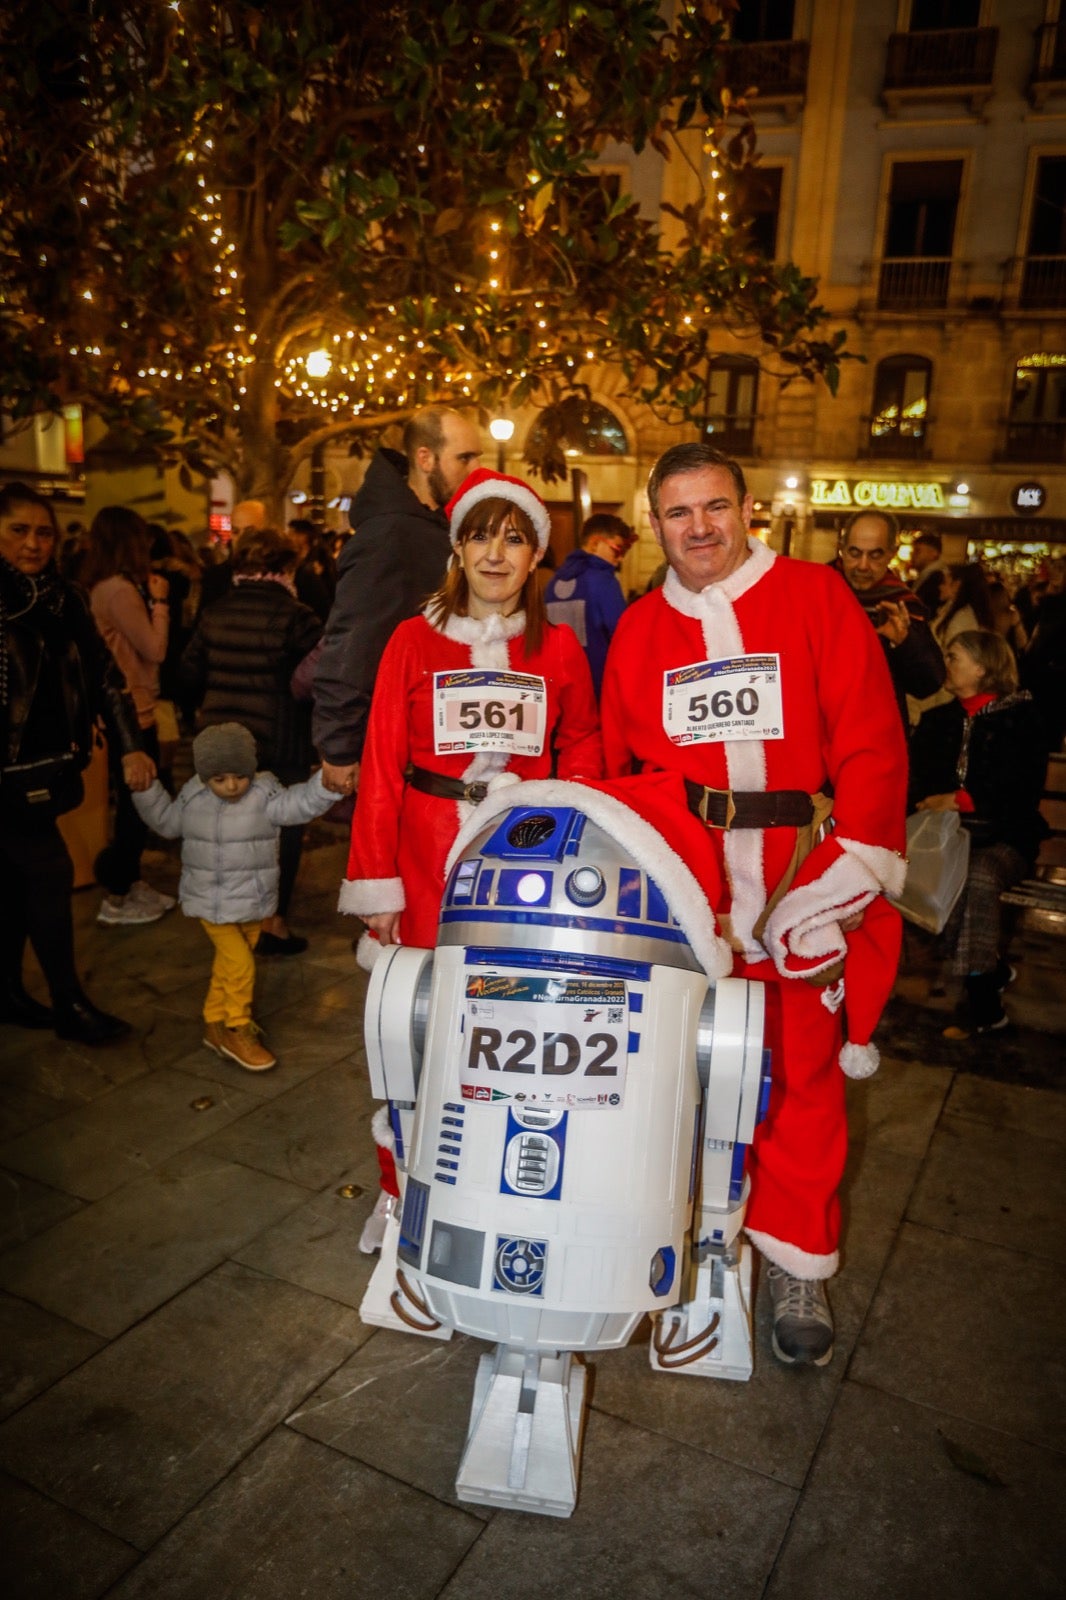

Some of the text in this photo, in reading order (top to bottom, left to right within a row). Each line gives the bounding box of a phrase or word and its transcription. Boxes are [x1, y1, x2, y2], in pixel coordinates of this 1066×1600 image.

[811, 479, 944, 508] LA CUEVA
[459, 701, 524, 731] 561
[688, 687, 759, 722] 560
[532, 993, 626, 1003] #NournaGranada2022
[468, 1026, 618, 1077] R2D2
